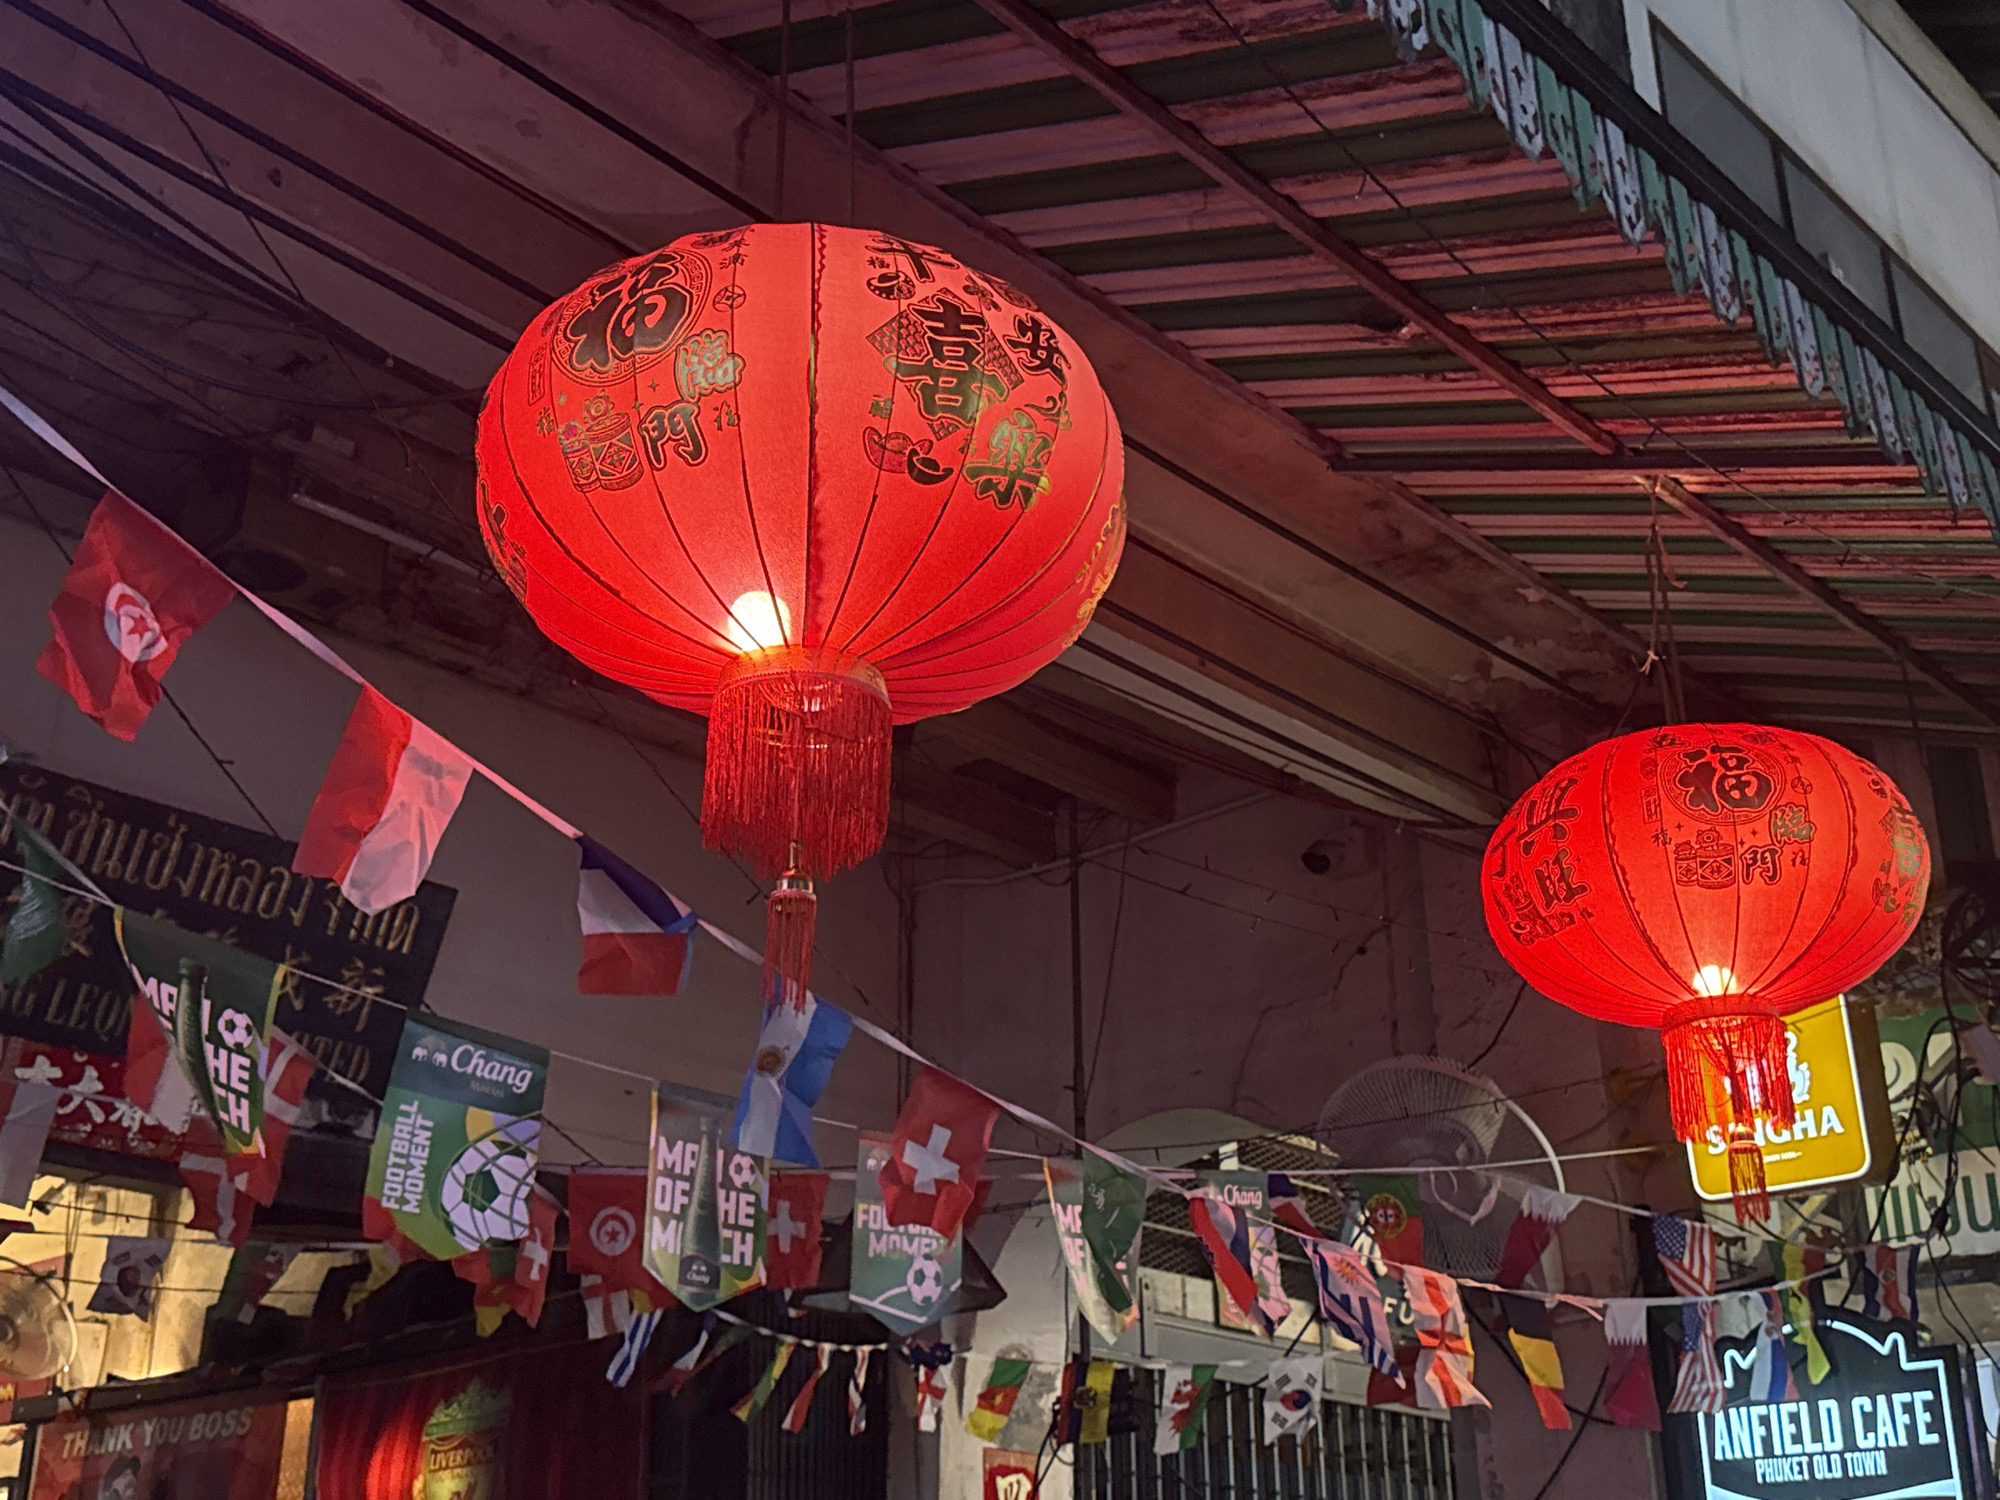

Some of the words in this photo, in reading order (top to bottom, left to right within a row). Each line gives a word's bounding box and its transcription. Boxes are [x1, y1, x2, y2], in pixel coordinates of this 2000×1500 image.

[564, 250, 693, 373] 福
[883, 294, 1010, 427] 喜
[637, 401, 706, 472] 門
[1674, 744, 1774, 815] 福
[205, 1041, 251, 1094] HE
[451, 1043, 533, 1094] Chang
[381, 1100, 419, 1211] FOOTBALL
[401, 1114, 434, 1215] MOMENT
[654, 1176, 690, 1214] OF
[718, 1187, 756, 1228] HE
[1224, 1184, 1263, 1210] Chang
[62, 1422, 135, 1460] THANK
[143, 1416, 185, 1447] YOU
[188, 1405, 255, 1442] BOSS
[1714, 1398, 1844, 1461] ANFIELD
[1850, 1390, 1941, 1450] CAFE
[1755, 1456, 1810, 1485] PHUKET
[1813, 1452, 1843, 1480] OLD
[1844, 1450, 1888, 1478] TOWN
